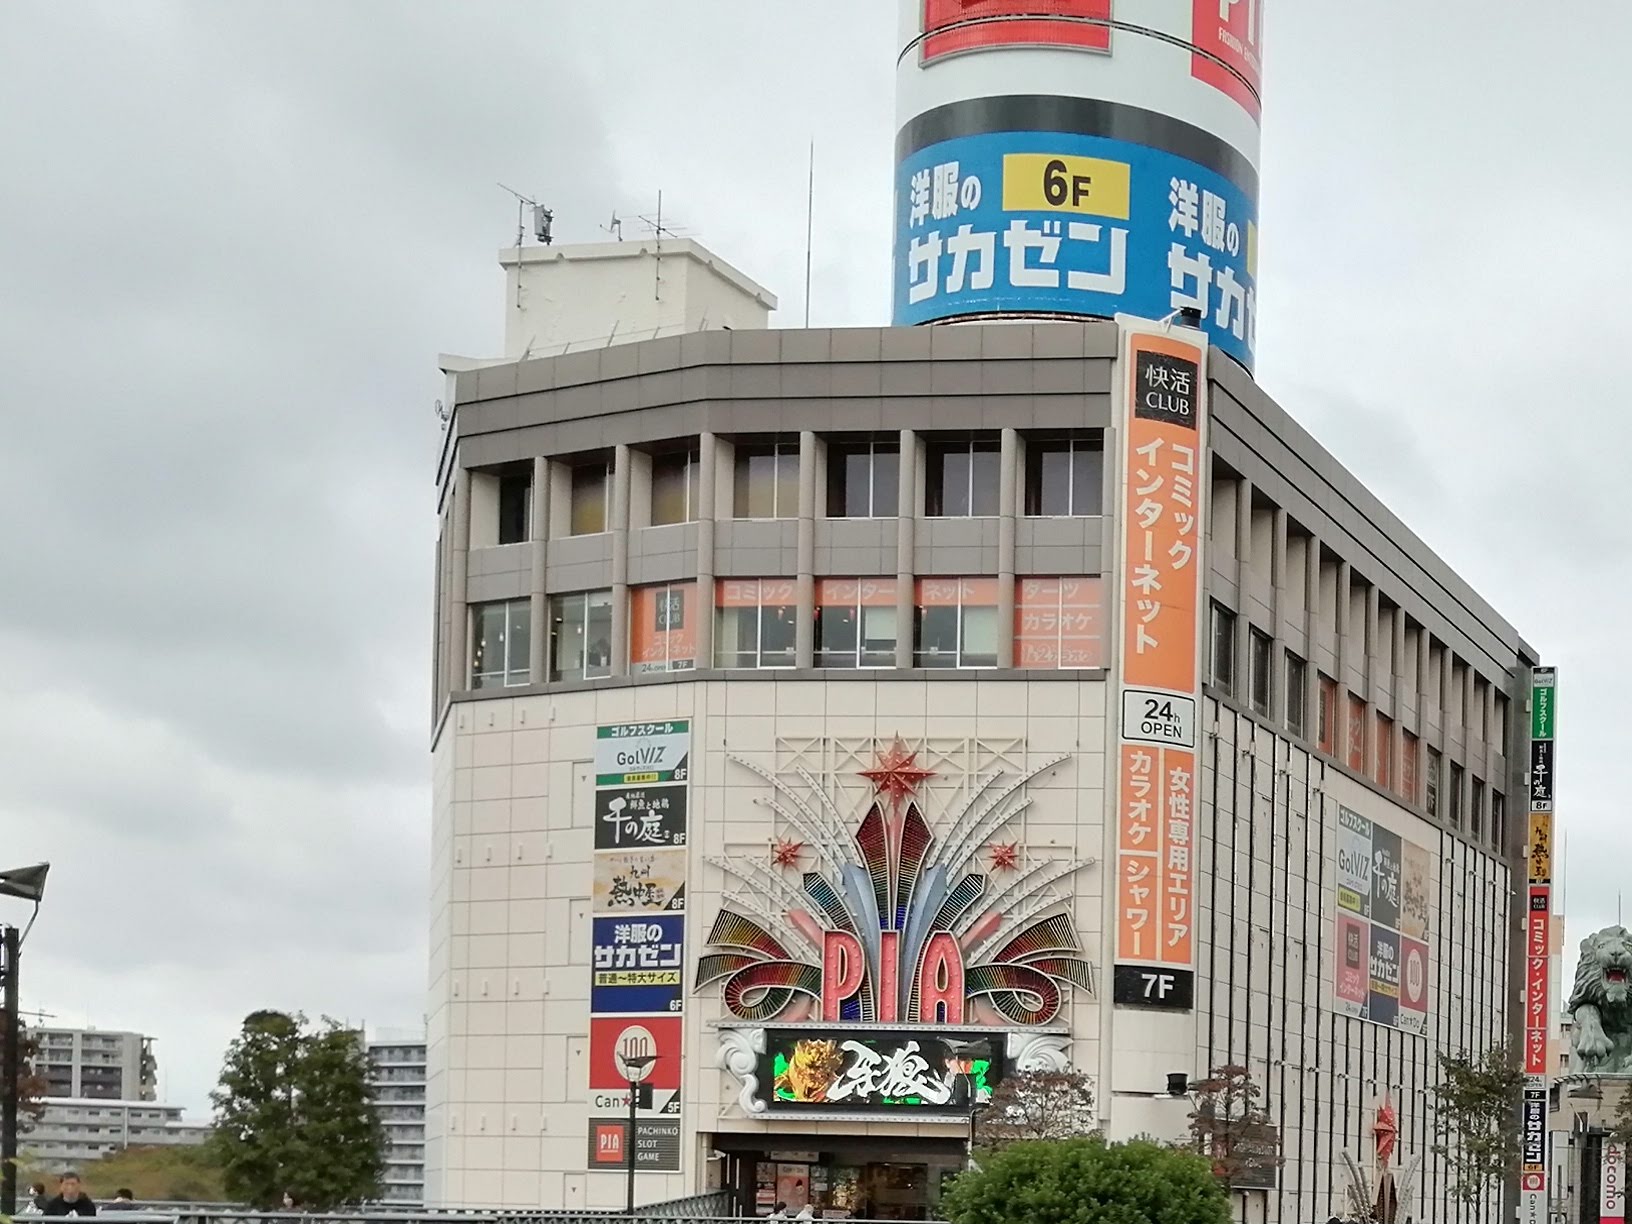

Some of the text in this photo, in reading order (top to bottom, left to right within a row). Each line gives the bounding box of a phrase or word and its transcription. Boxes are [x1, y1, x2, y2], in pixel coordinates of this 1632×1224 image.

[1043, 160, 1091, 207] 6F
[909, 161, 982, 229] 洋服の
[1168, 176, 1240, 257] 洋服の
[908, 219, 1129, 305] サカゼン
[1145, 364, 1191, 395] 快活
[1146, 391, 1190, 416] CLUB
[1168, 443, 1195, 570] コミック
[1131, 437, 1165, 654] インターネット
[726, 582, 793, 601] コミック
[1023, 613, 1093, 631] カラオケ
[611, 723, 674, 737] ゴルフスクール
[1141, 721, 1183, 740] OPEN
[674, 768, 687, 780] 8F
[1128, 750, 1152, 845] カラオケ
[673, 833, 686, 844] 8F
[1168, 766, 1192, 947] 女性専用エリア
[671, 898, 684, 909] 8F
[1126, 860, 1150, 956] シャワー
[614, 924, 663, 943] 洋服の
[594, 943, 682, 969] サカゼン
[821, 929, 965, 1025] PIA
[1141, 973, 1175, 999] 7F
[669, 1000, 682, 1011] 6F
[1530, 1091, 1541, 1099] 7F
[667, 1102, 681, 1113] 5F
[600, 1135, 620, 1151] PIA
[637, 1127, 679, 1137] PACHINKO
[637, 1140, 658, 1149] SLOT
[637, 1152, 660, 1162] GAME
[1606, 1144, 1621, 1210] docomo
